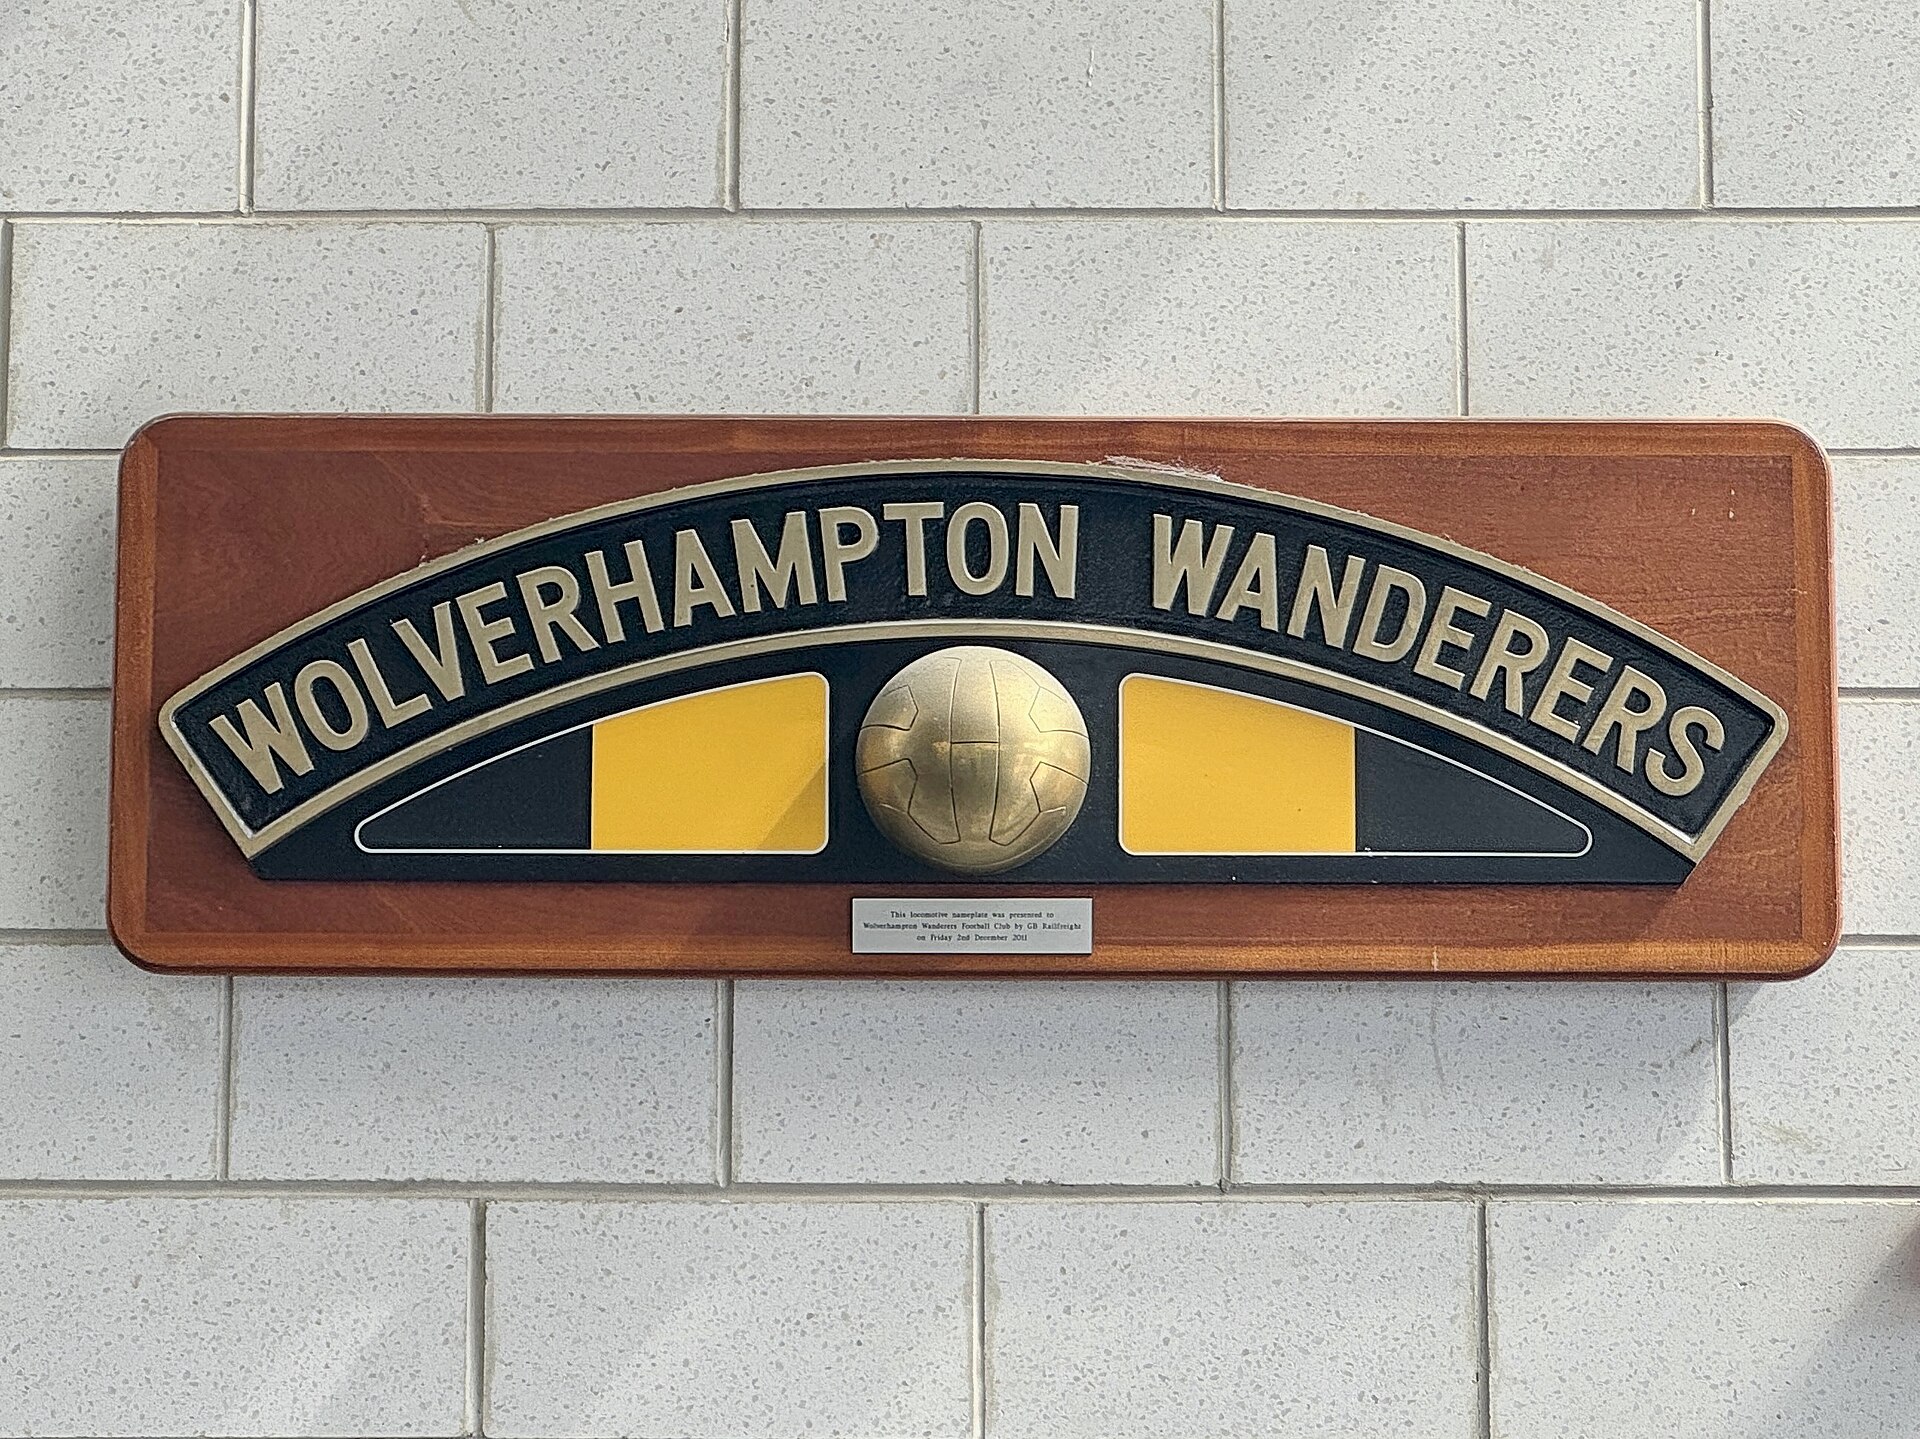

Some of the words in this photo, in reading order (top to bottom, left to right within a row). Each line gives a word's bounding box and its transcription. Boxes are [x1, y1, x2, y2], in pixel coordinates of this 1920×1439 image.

[208, 501, 1080, 796] WOLVERHAMPTON
[1152, 513, 1725, 797] WANDERERS
[890, 910, 906, 918] This
[910, 910, 949, 918] locomotive
[952, 910, 988, 919] nameplate
[1009, 910, 1043, 919] presented
[863, 922, 918, 931] Wolverhampton
[921, 922, 958, 930] Wanderers
[961, 922, 990, 930] Football
[993, 922, 1011, 930] Club
[1014, 922, 1024, 931] by
[1026, 922, 1038, 930] GB
[1042, 922, 1081, 931] Railfreight
[930, 933, 953, 942] Friday
[956, 933, 971, 941] 2nd
[974, 933, 1008, 941] December
[1012, 933, 1028, 941] 2011
